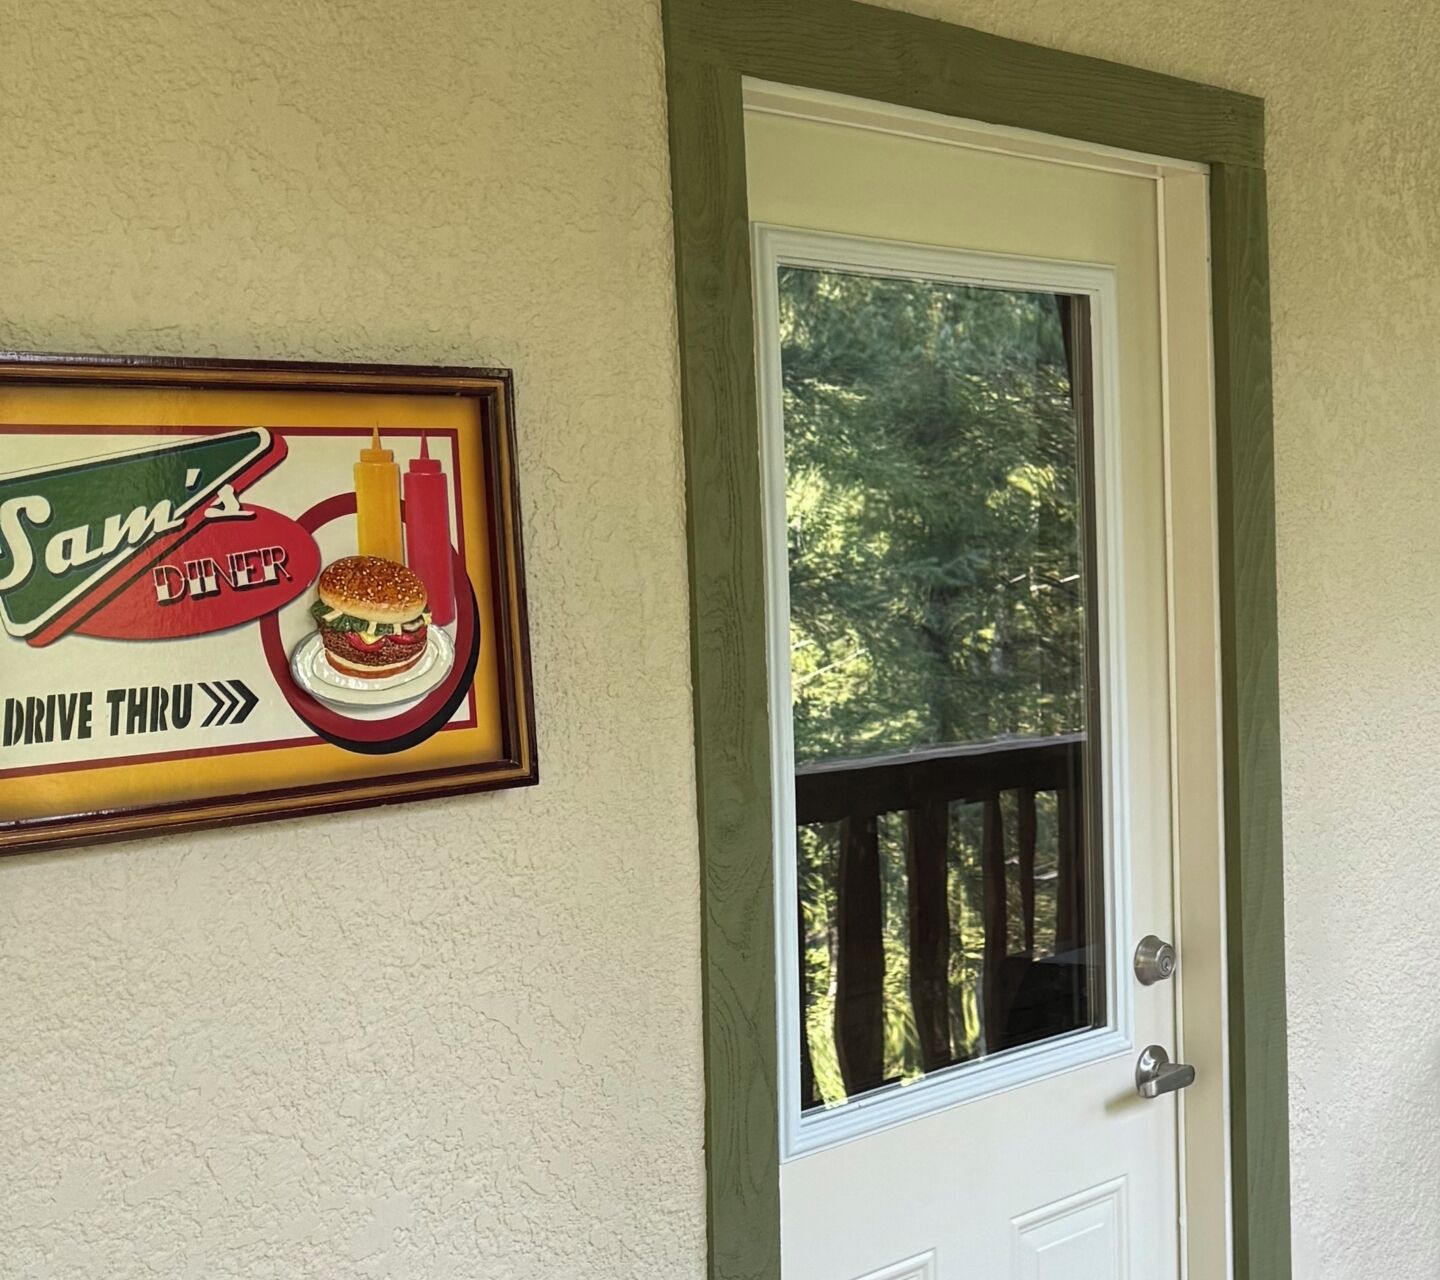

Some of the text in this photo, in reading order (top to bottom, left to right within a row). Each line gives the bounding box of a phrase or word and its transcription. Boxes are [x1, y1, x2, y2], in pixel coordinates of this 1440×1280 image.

[0, 468, 255, 590] Sam's
[152, 545, 292, 604] DINER
[3, 683, 193, 747] DRIVE THRU
